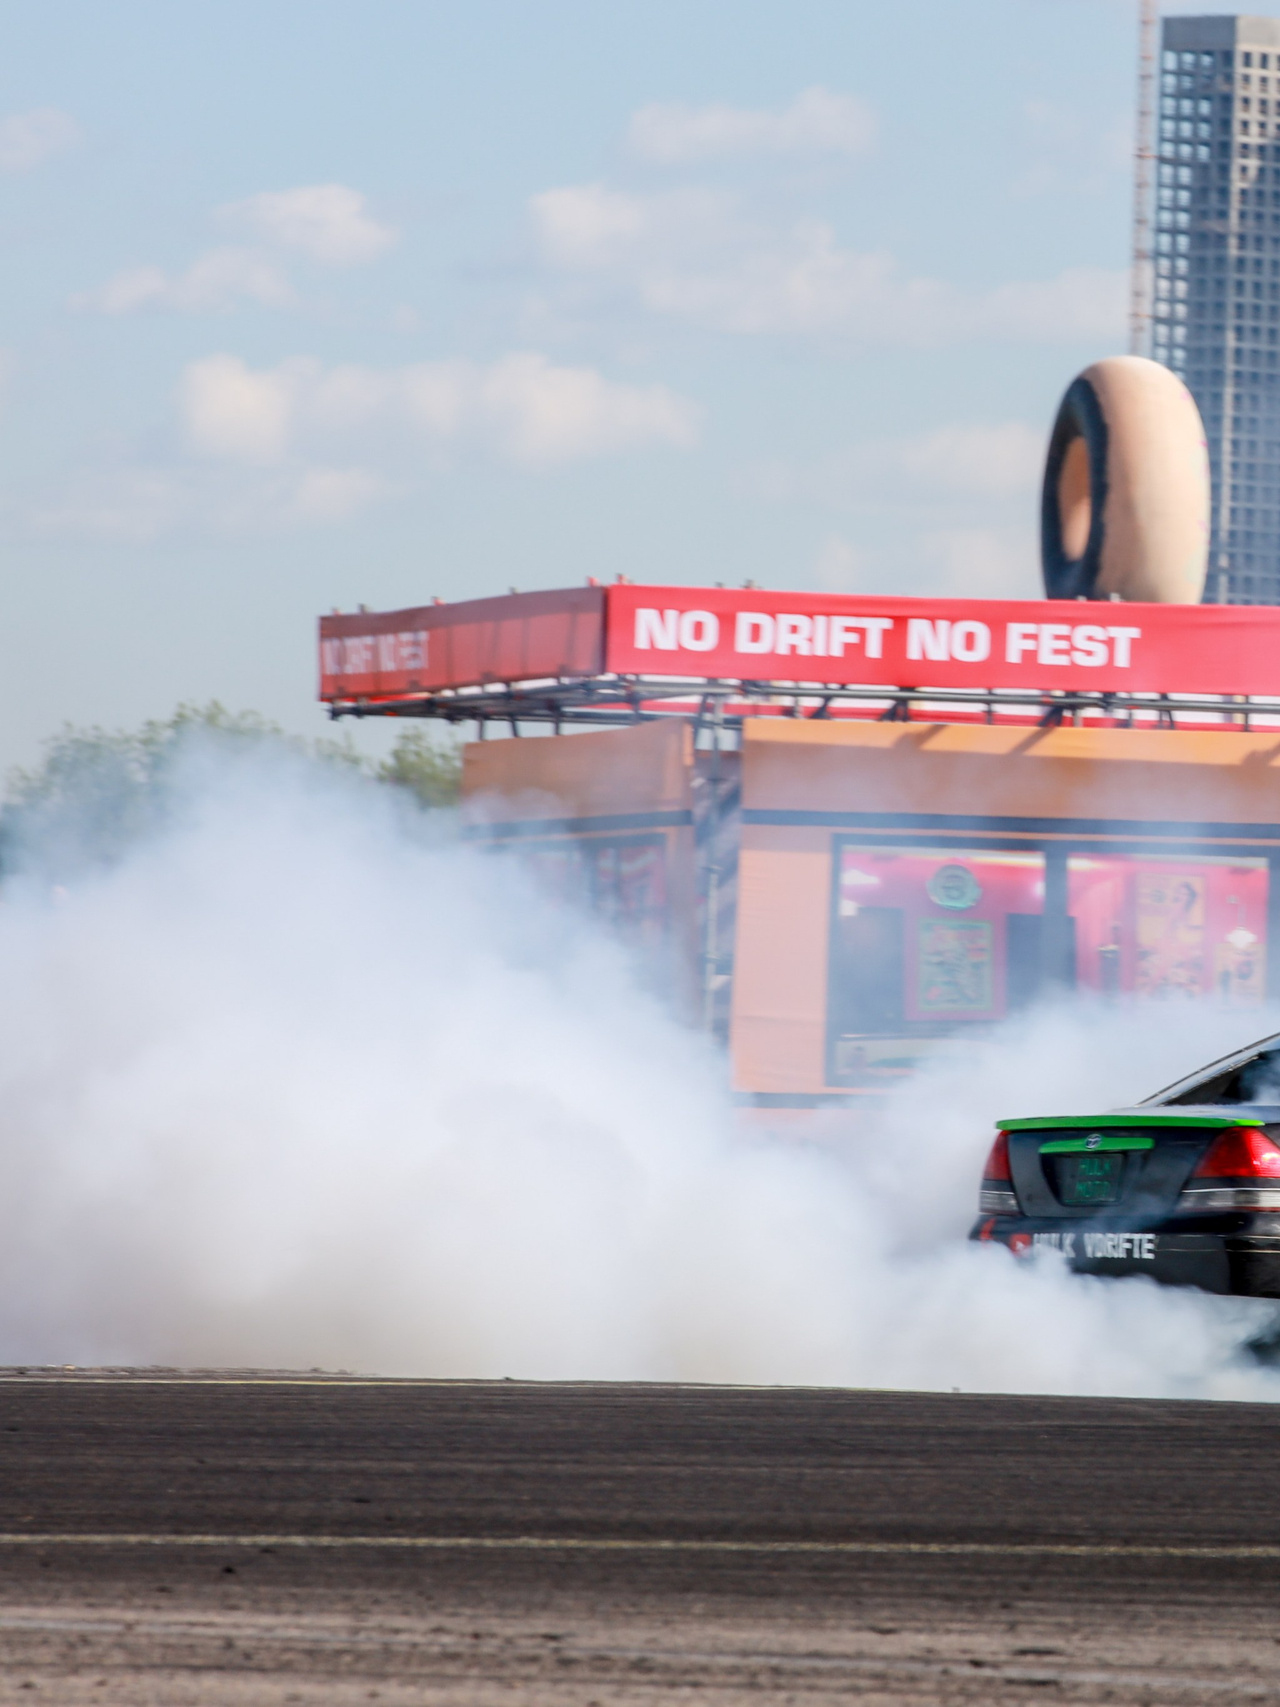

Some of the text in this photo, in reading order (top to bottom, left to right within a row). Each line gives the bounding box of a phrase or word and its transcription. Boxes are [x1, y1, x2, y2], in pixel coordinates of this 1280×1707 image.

[634, 608, 1142, 667] NO DRIFT NO FEST
